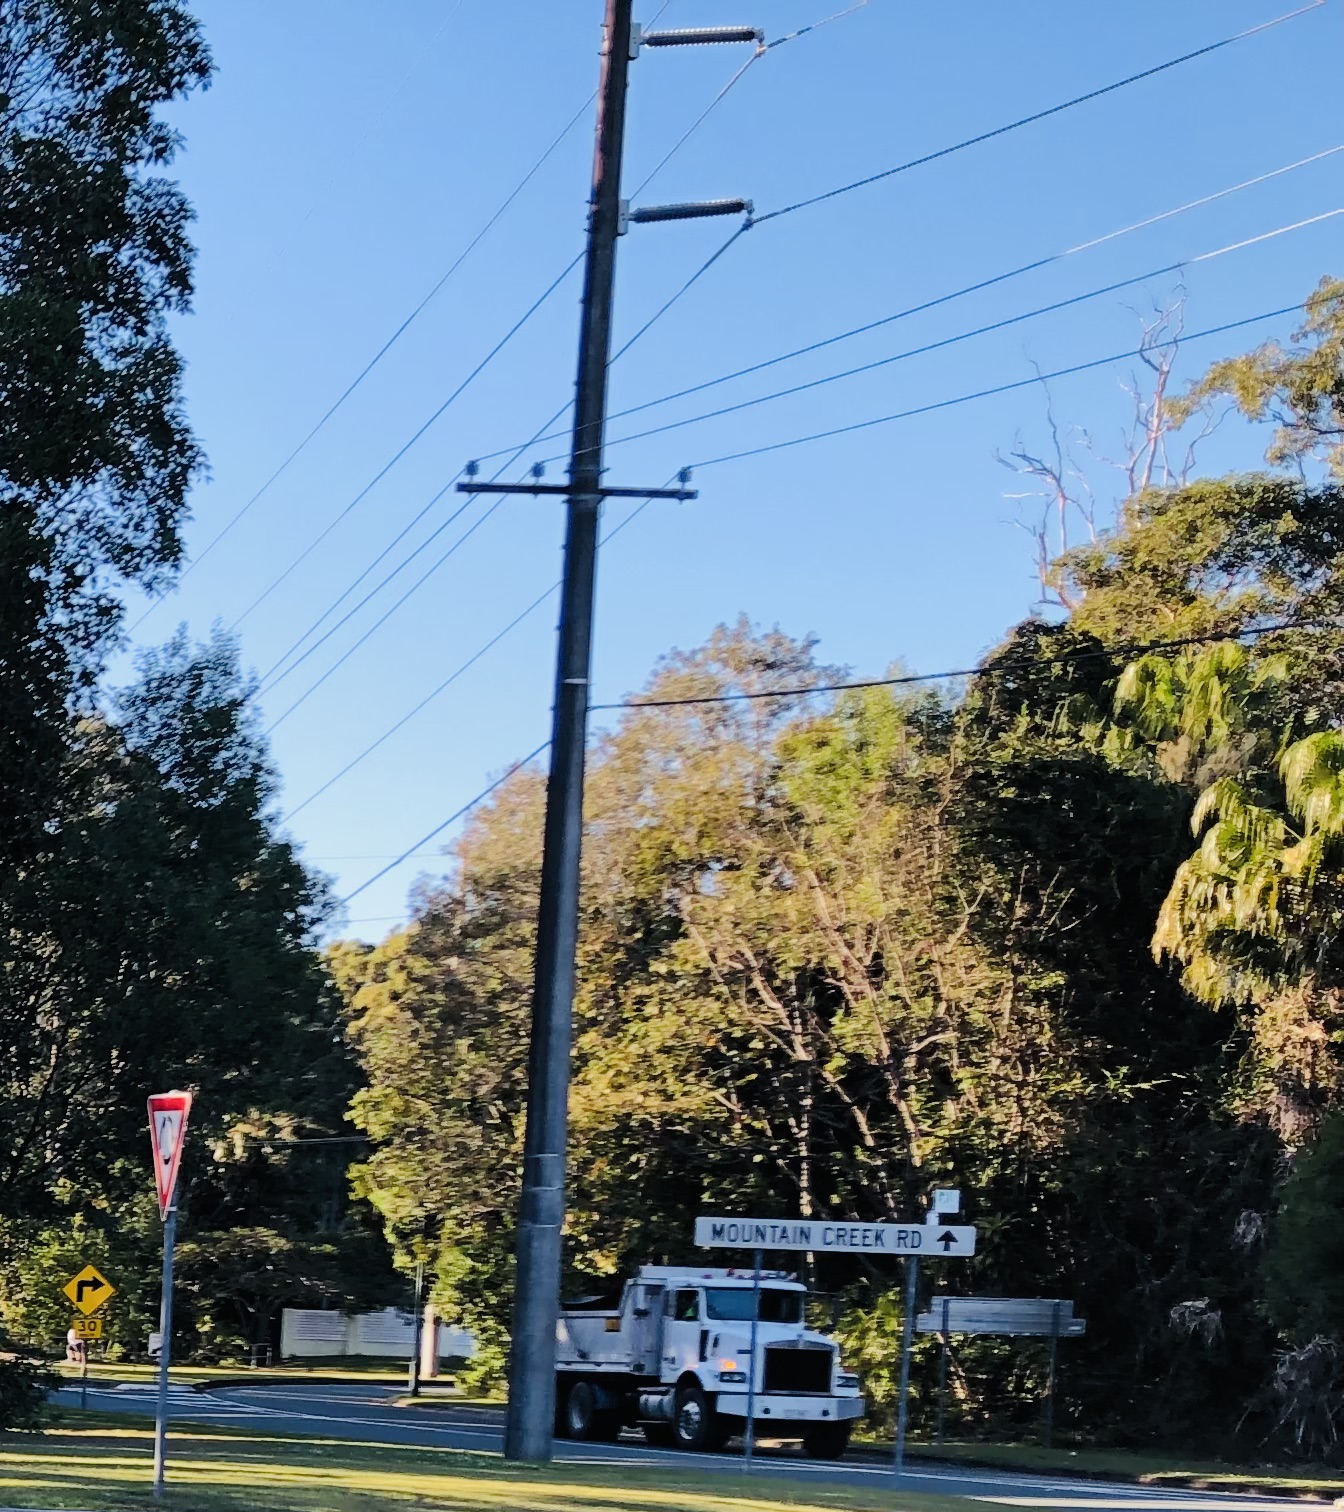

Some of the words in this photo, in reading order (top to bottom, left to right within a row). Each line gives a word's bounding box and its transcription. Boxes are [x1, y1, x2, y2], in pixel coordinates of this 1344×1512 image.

[712, 1223, 811, 1245] MOUNTAIN
[823, 1226, 885, 1248] CREEK
[896, 1229, 922, 1249] RD
[77, 1320, 97, 1332] 30
